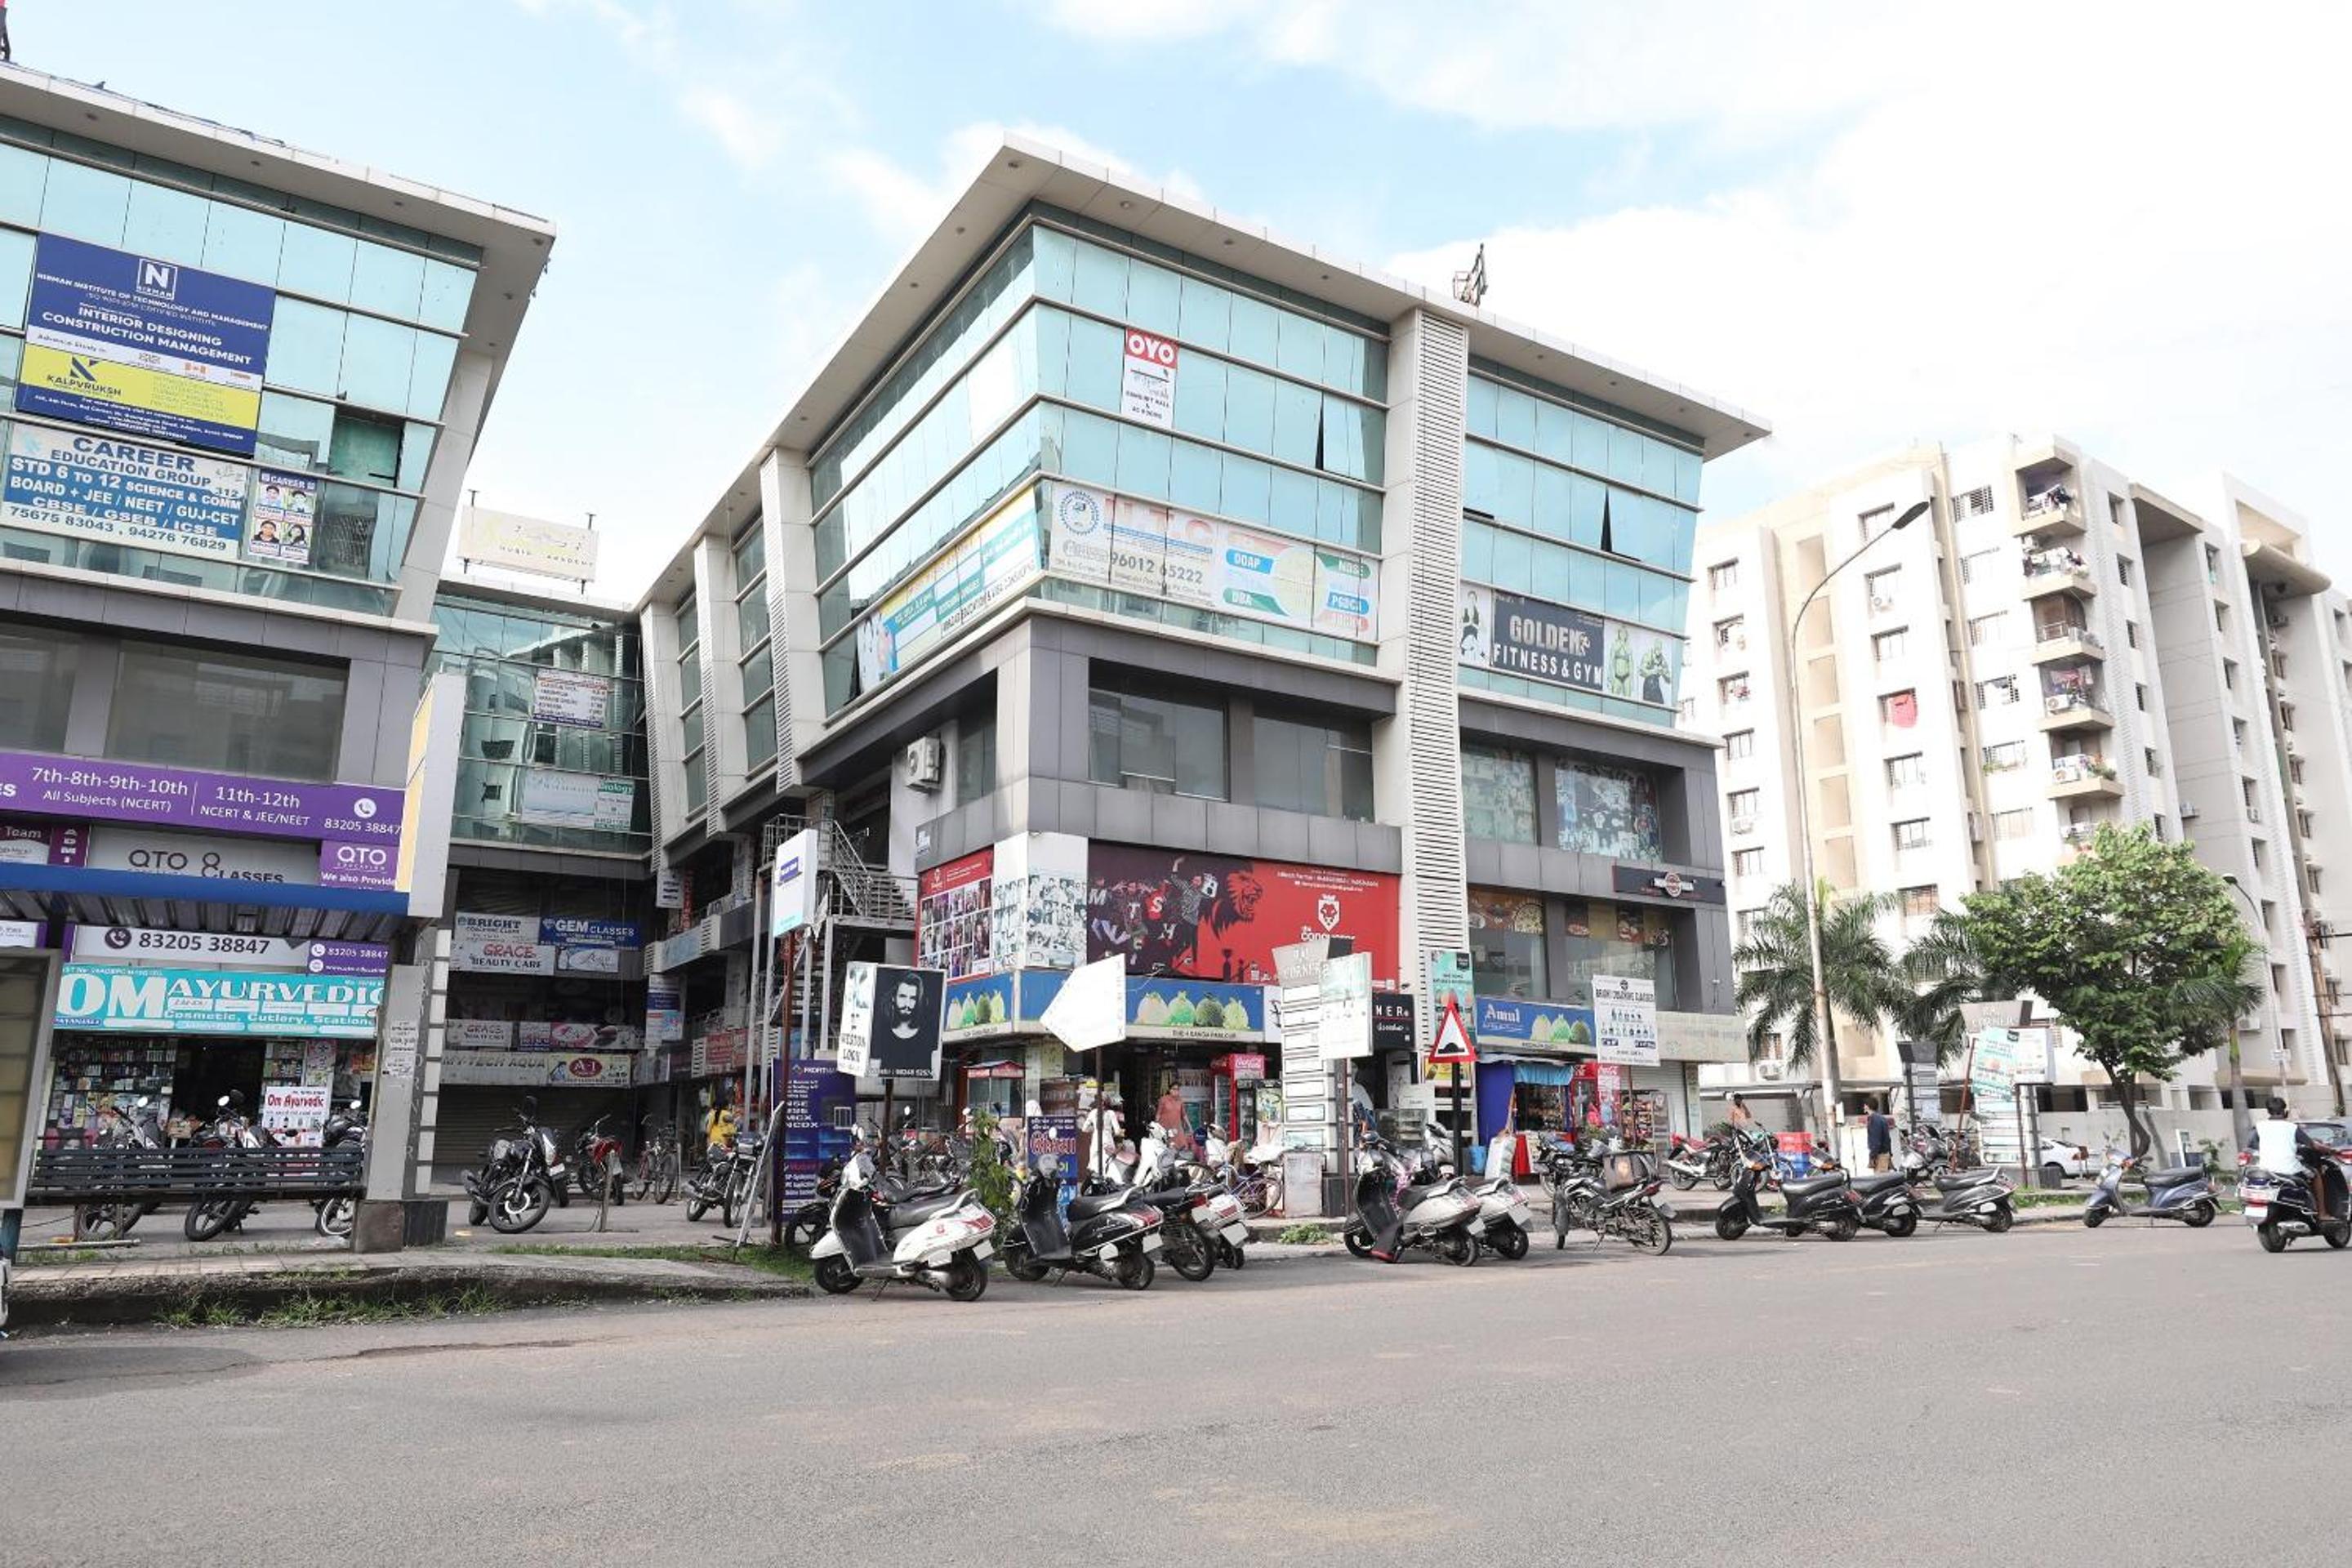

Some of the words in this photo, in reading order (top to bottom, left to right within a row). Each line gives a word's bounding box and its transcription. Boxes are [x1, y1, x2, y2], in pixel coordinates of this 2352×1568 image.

[145, 263, 170, 287] N
[79, 307, 144, 330] INTERIOR
[147, 321, 222, 346] DESIGNING
[42, 311, 154, 345] CONSTRUCTION
[158, 337, 252, 365] MANAGEMENT
[1129, 334, 1174, 364] OYO
[47, 374, 122, 397] KALPVRUKSH
[74, 437, 195, 472] CAREER
[51, 450, 150, 478] EDUCATION
[155, 469, 211, 488] GROUP
[11, 458, 51, 474] STD
[57, 465, 68, 479] 6
[100, 473, 120, 488] 12
[127, 481, 184, 501] SCIENCE
[188, 492, 198, 502] &
[203, 493, 241, 510] COMM
[270, 475, 305, 488] CAREER
[11, 476, 65, 497] BOARD
[83, 489, 112, 504] JEE
[125, 497, 166, 515] NEET
[176, 506, 238, 525] GUJ-CET
[33, 497, 87, 515] CBSE
[105, 509, 157, 528] GSEB
[174, 521, 217, 537] ICSE
[11, 506, 59, 524] 75675
[65, 515, 114, 532] 83043
[128, 526, 176, 543] 94276
[181, 535, 227, 552] 76829
[1111, 552, 1155, 573] 96012
[1511, 615, 1581, 656] GOLDEN
[1494, 644, 1557, 676] FITNESS
[1561, 661, 1570, 677] &
[1574, 662, 1602, 685] GYM
[32, 767, 189, 796] 7th-8th-9th-10th
[42, 789, 60, 801] All
[64, 791, 118, 808] Subjects
[121, 795, 173, 813] (NCERT)
[216, 786, 301, 808] 11th-12th
[200, 804, 239, 818] NCERT
[243, 809, 252, 821] &
[255, 811, 310, 826] JEE/NEET
[6, 826, 42, 839] Team
[324, 817, 361, 831] 83205
[365, 822, 402, 836] 38847
[128, 849, 188, 871] QTO
[337, 845, 387, 866] QTO
[322, 871, 337, 882] We
[339, 874, 359, 884] also
[467, 916, 521, 929] BRIGHT
[555, 920, 589, 933] GEM
[139, 932, 202, 951] 83205
[207, 936, 270, 955] 38847
[327, 947, 357, 958] 83205
[359, 949, 389, 960] 38847
[483, 943, 536, 959] GRACE
[471, 957, 512, 968] BEAUTY
[56, 973, 167, 1019] OM
[167, 977, 385, 1005] AYURVEDIC
[164, 1010, 241, 1023] Cosmetic,
[247, 1013, 308, 1026] Cutlery,
[1484, 1003, 1521, 1024] Amul
[508, 1055, 546, 1068] AQUA
[267, 1094, 282, 1107] Om
[284, 1094, 325, 1109] Ayurvedic
